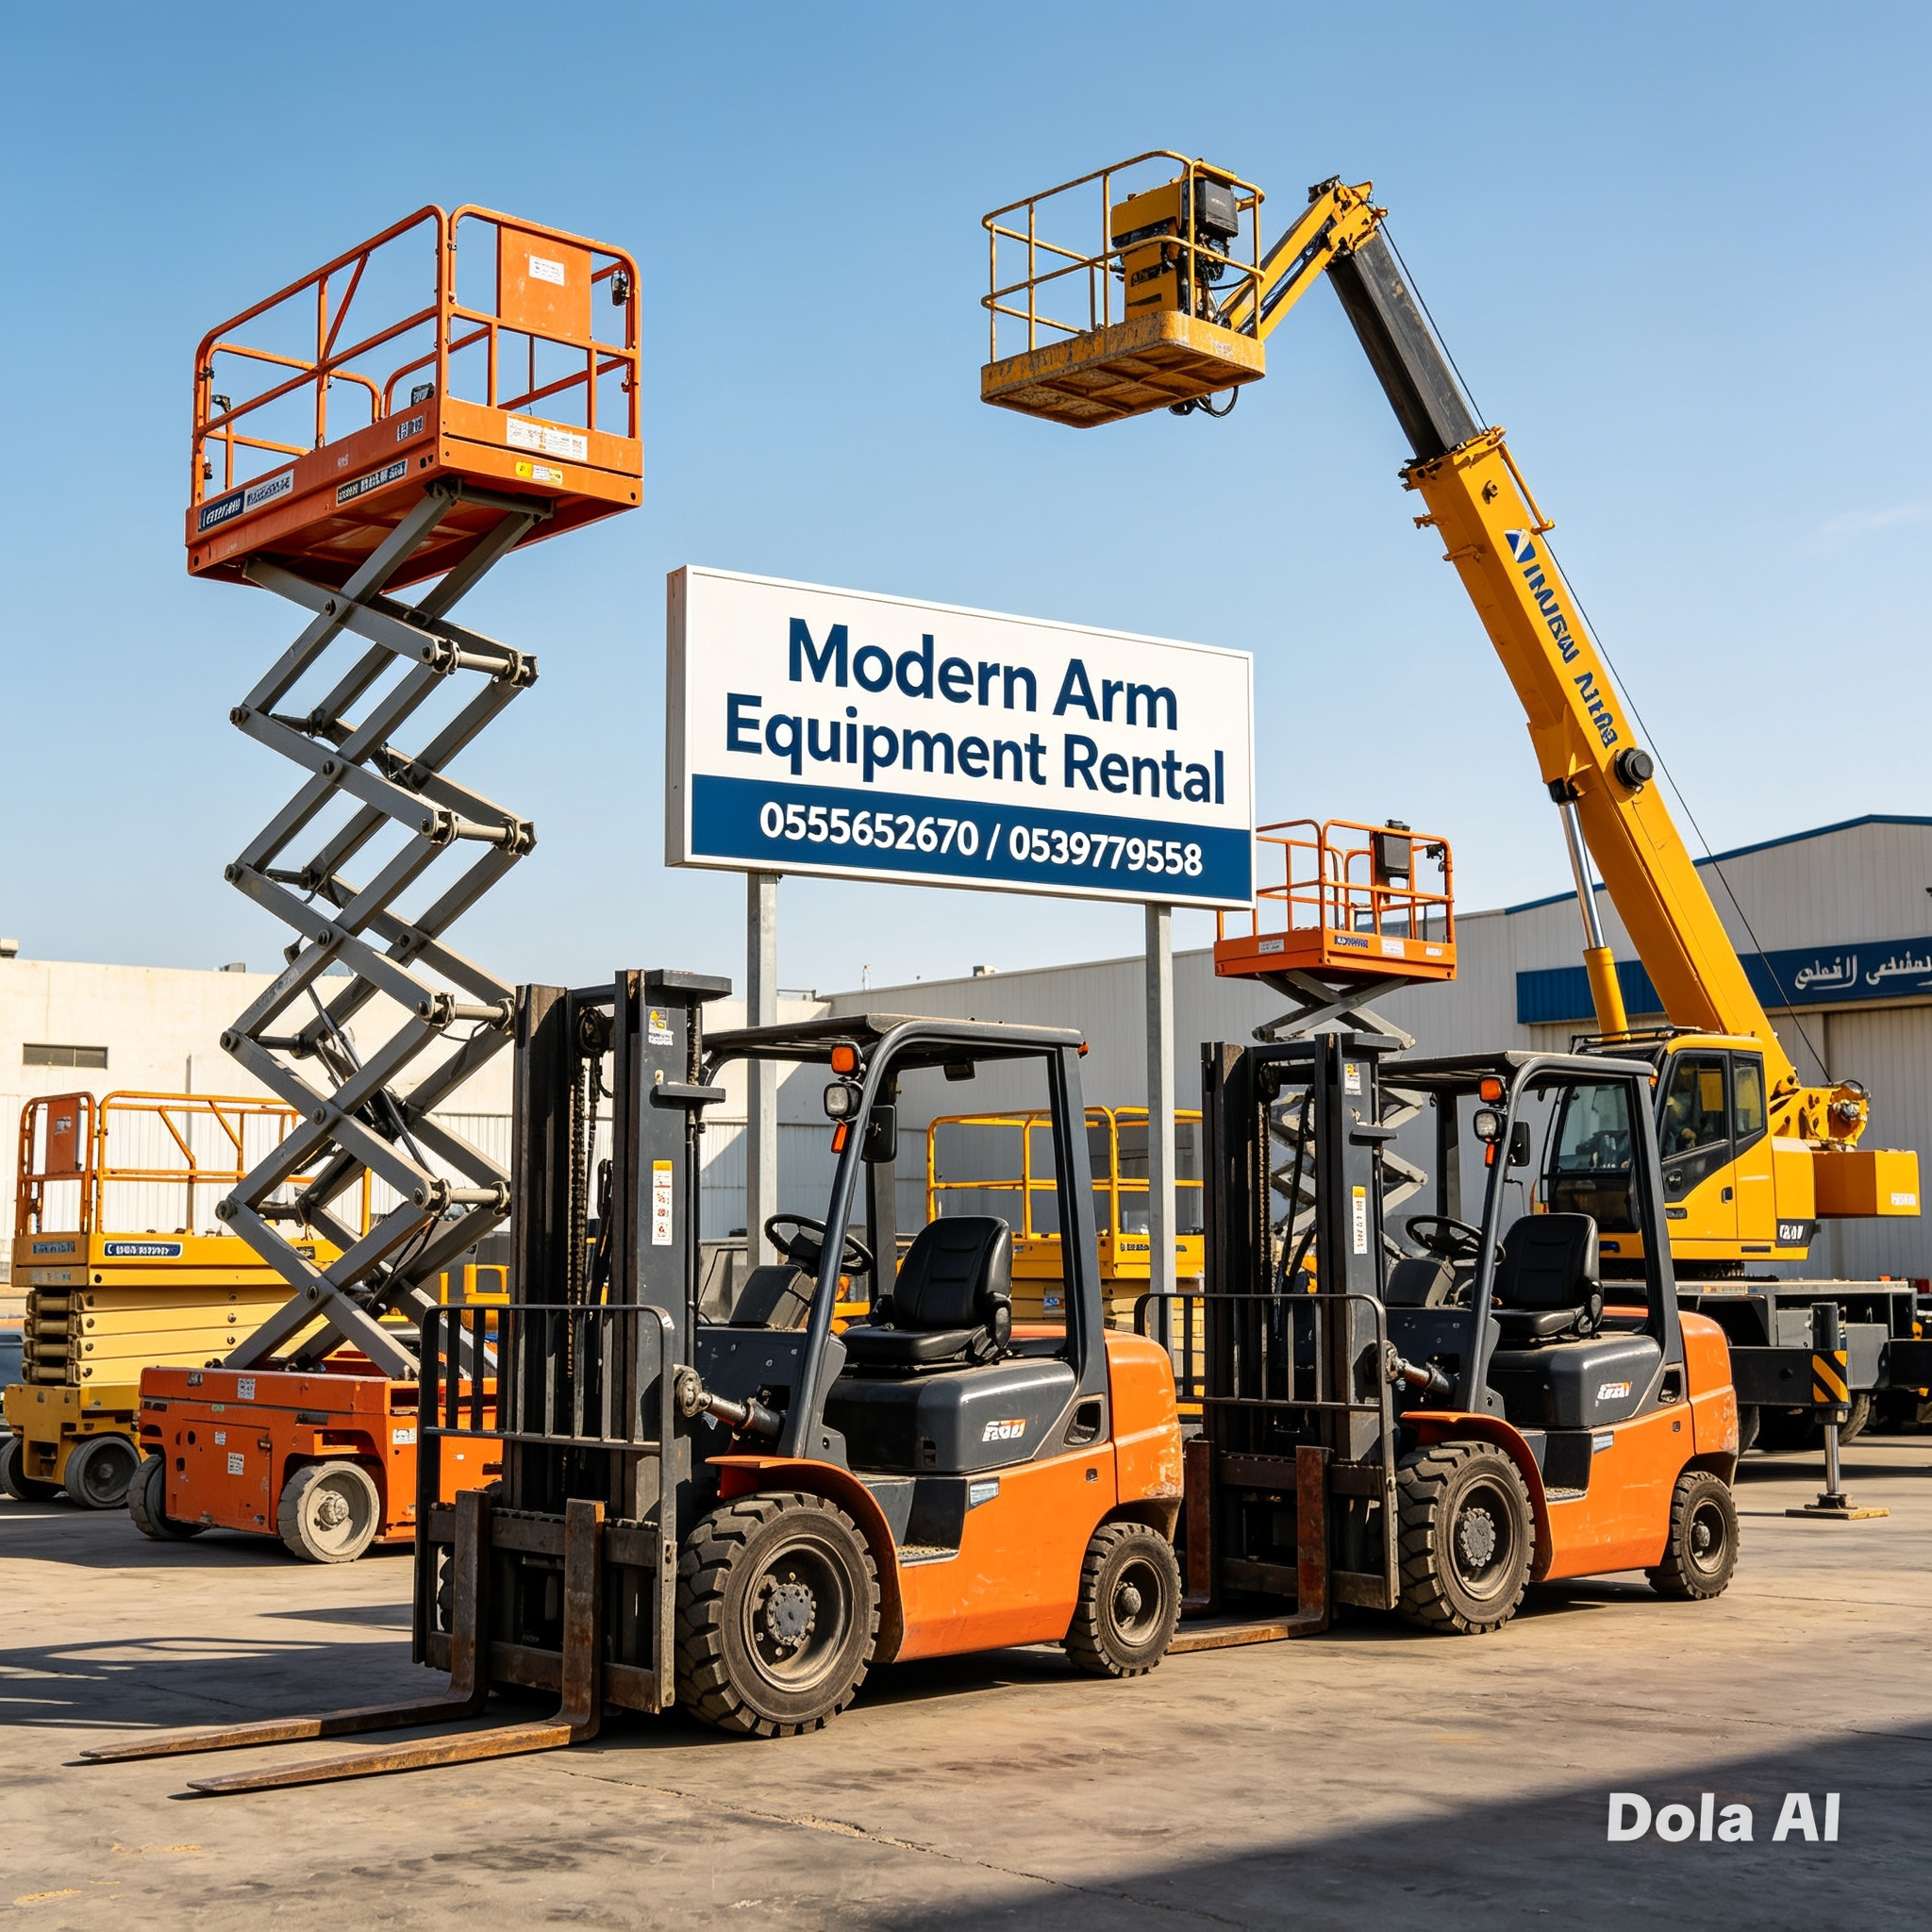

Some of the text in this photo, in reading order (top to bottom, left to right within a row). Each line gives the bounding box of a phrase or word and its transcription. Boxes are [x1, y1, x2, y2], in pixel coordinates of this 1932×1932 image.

[789, 617, 1178, 731] Modern Arm
[726, 691, 1224, 805] Equipment Rental
[759, 801, 1204, 876] 0555652670 / 0539779558
